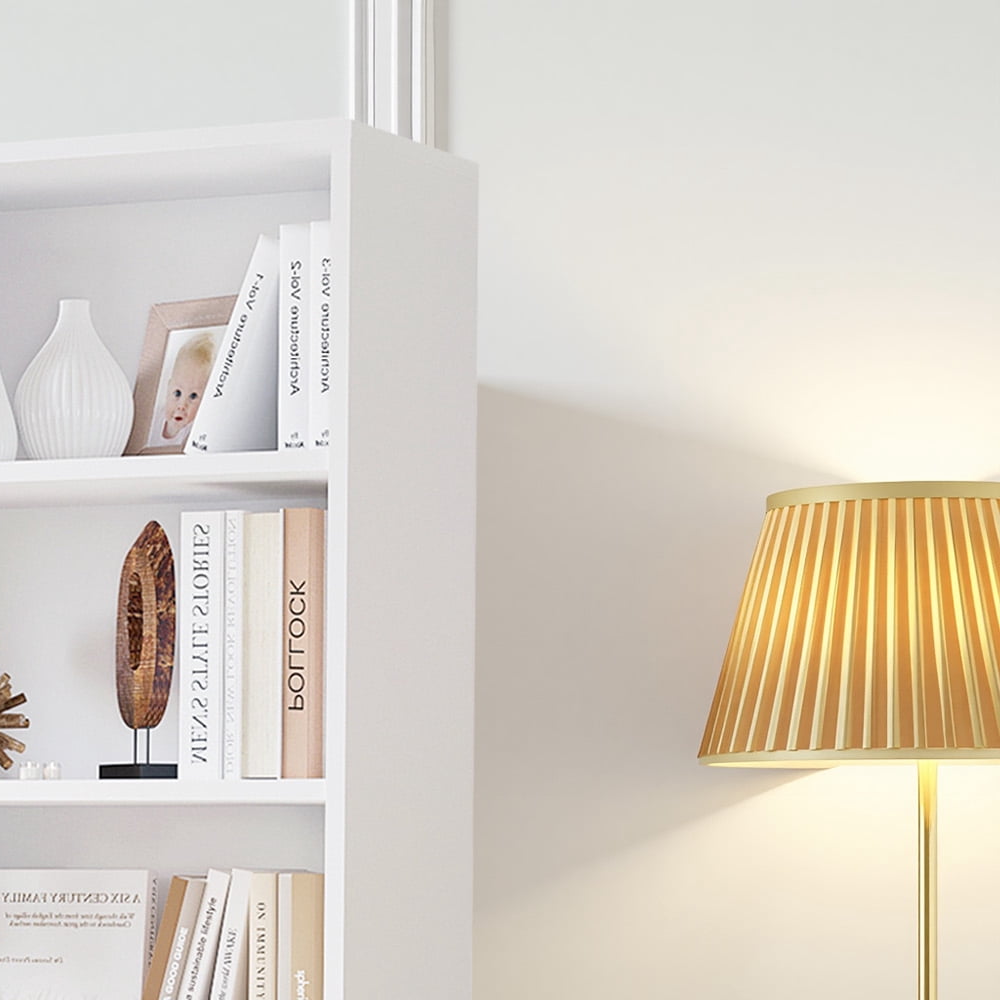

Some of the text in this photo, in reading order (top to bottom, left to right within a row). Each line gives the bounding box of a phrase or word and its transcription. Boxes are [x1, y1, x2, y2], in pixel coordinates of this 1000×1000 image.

[166, 962, 180, 994] GOOD
[174, 927, 188, 961] GUIDE
[187, 937, 207, 992] sustainable
[201, 897, 218, 935] lifestyle
[256, 902, 266, 1000] ON IMMUNITY
